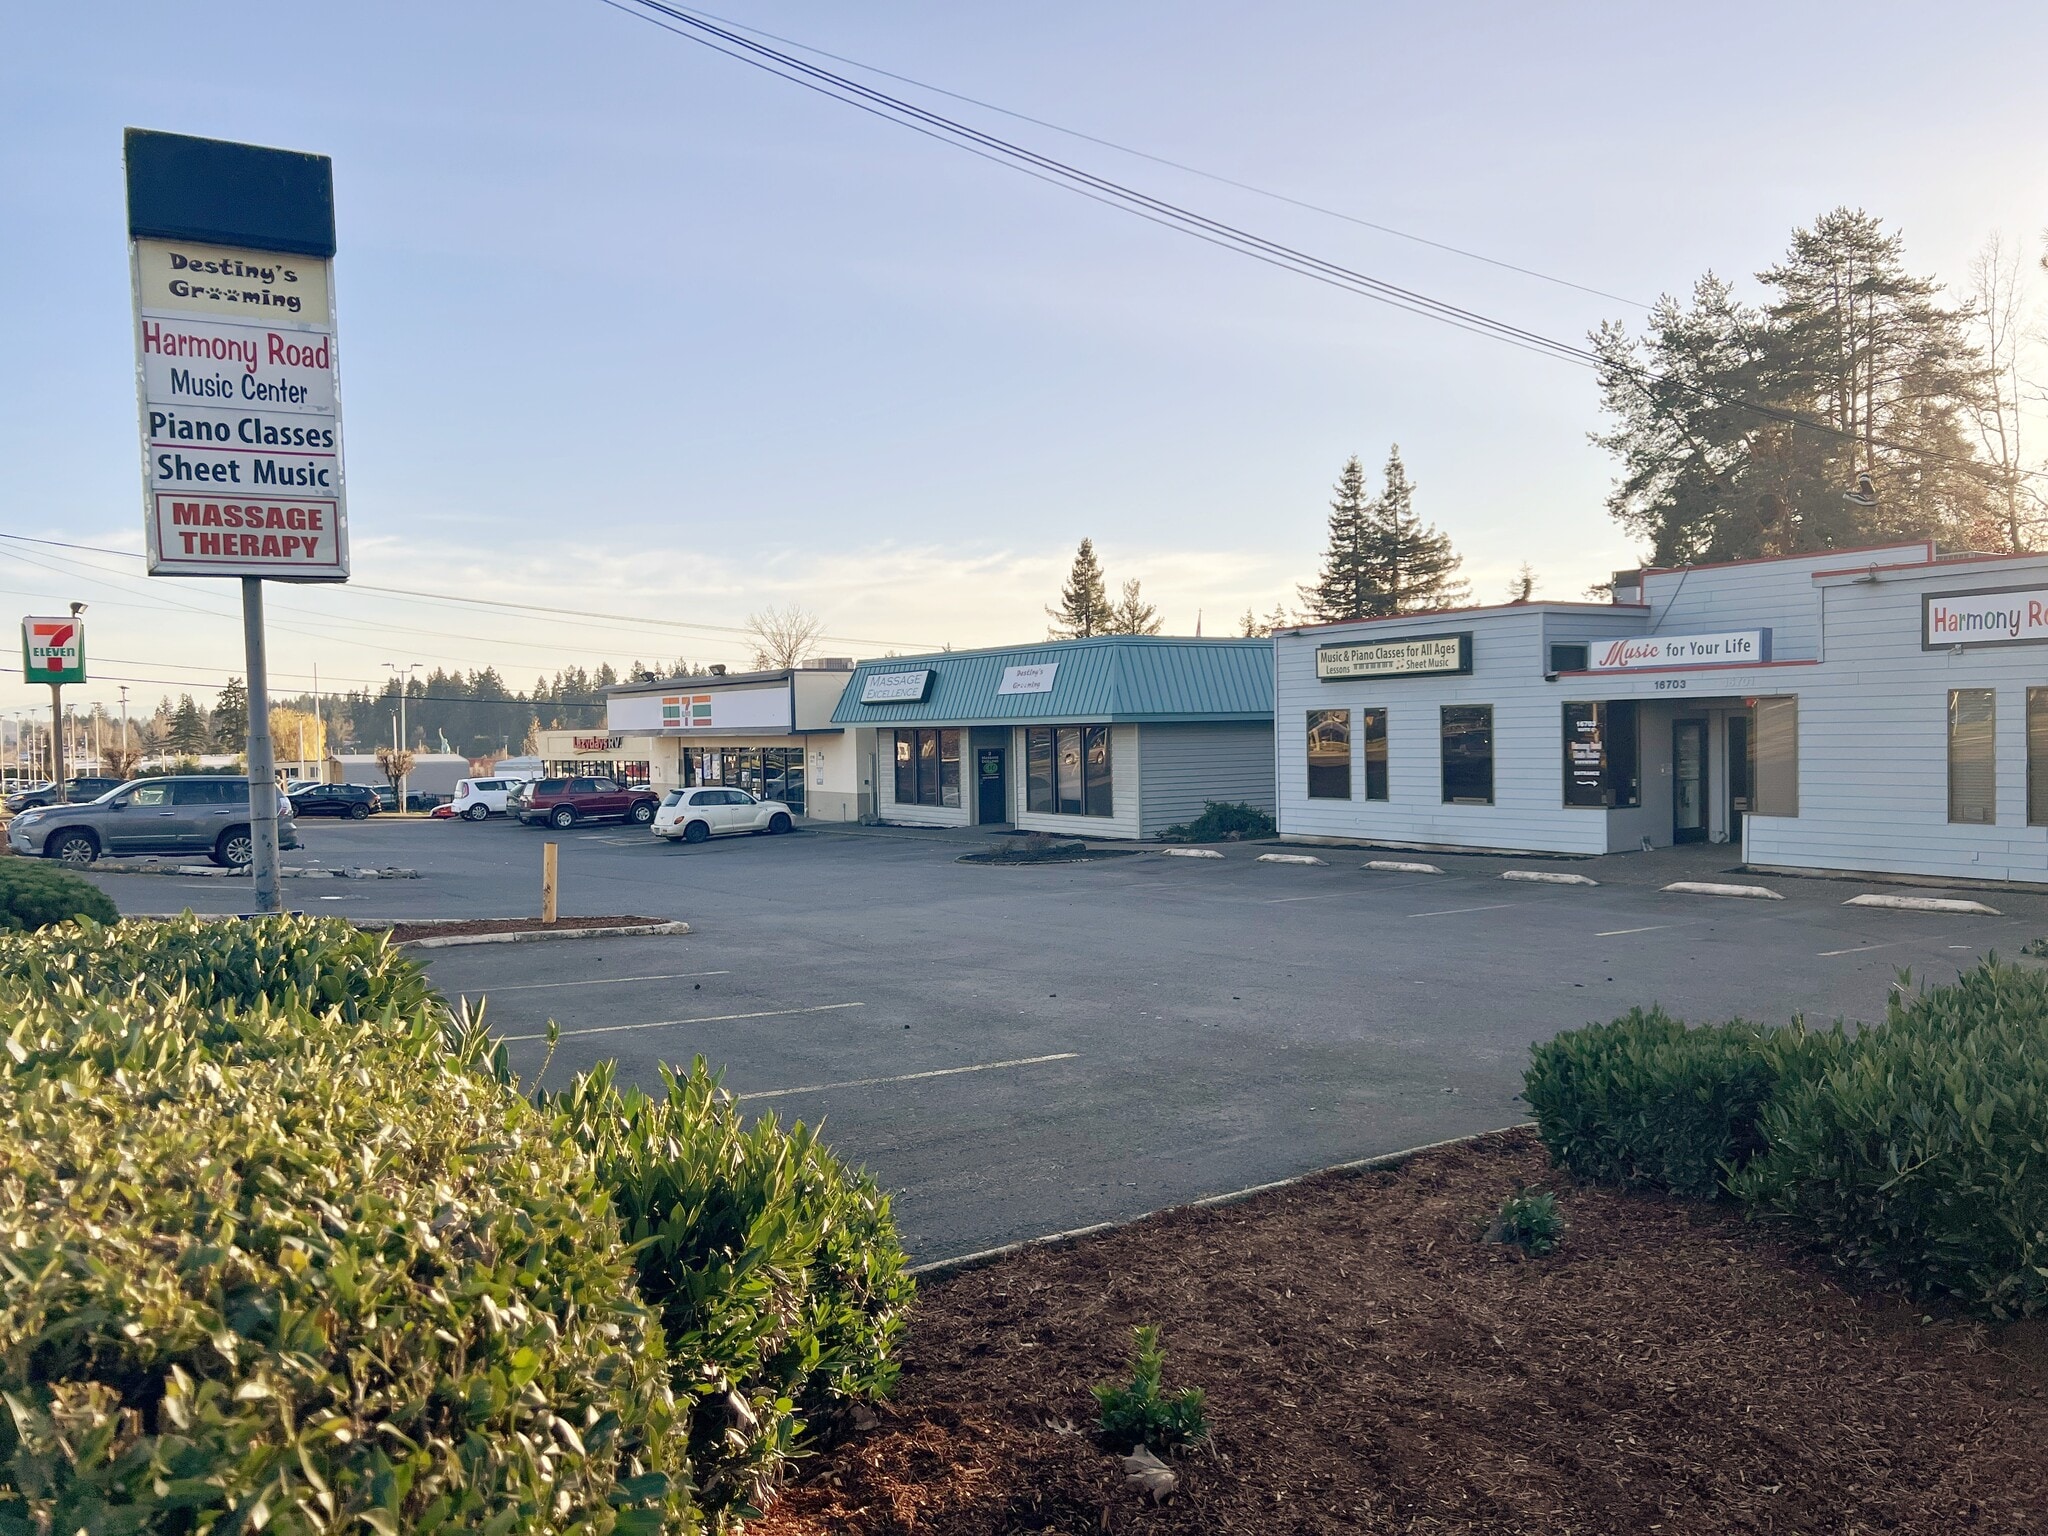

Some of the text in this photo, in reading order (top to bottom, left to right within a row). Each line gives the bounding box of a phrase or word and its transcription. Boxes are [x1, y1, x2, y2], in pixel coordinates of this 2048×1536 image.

[168, 252, 298, 284] Destiny's
[142, 320, 329, 374] Harmony Road
[170, 367, 308, 403] Music Center
[150, 411, 334, 448] Piano Classes
[157, 454, 330, 487] Sheet Music
[172, 502, 323, 531] MASSAGE
[178, 531, 319, 558] THERAPY
[1934, 607, 2021, 637] Harmony
[33, 624, 73, 671] 7
[1320, 643, 1456, 663] Music & Piano Classes for All Ages
[1599, 638, 1751, 667] Music for Your Life
[869, 674, 923, 687] MASSAGE
[1325, 658, 1449, 675] Lessons Sheet Music
[866, 687, 919, 699] EXCELLENCE
[1654, 680, 1687, 690] 16703
